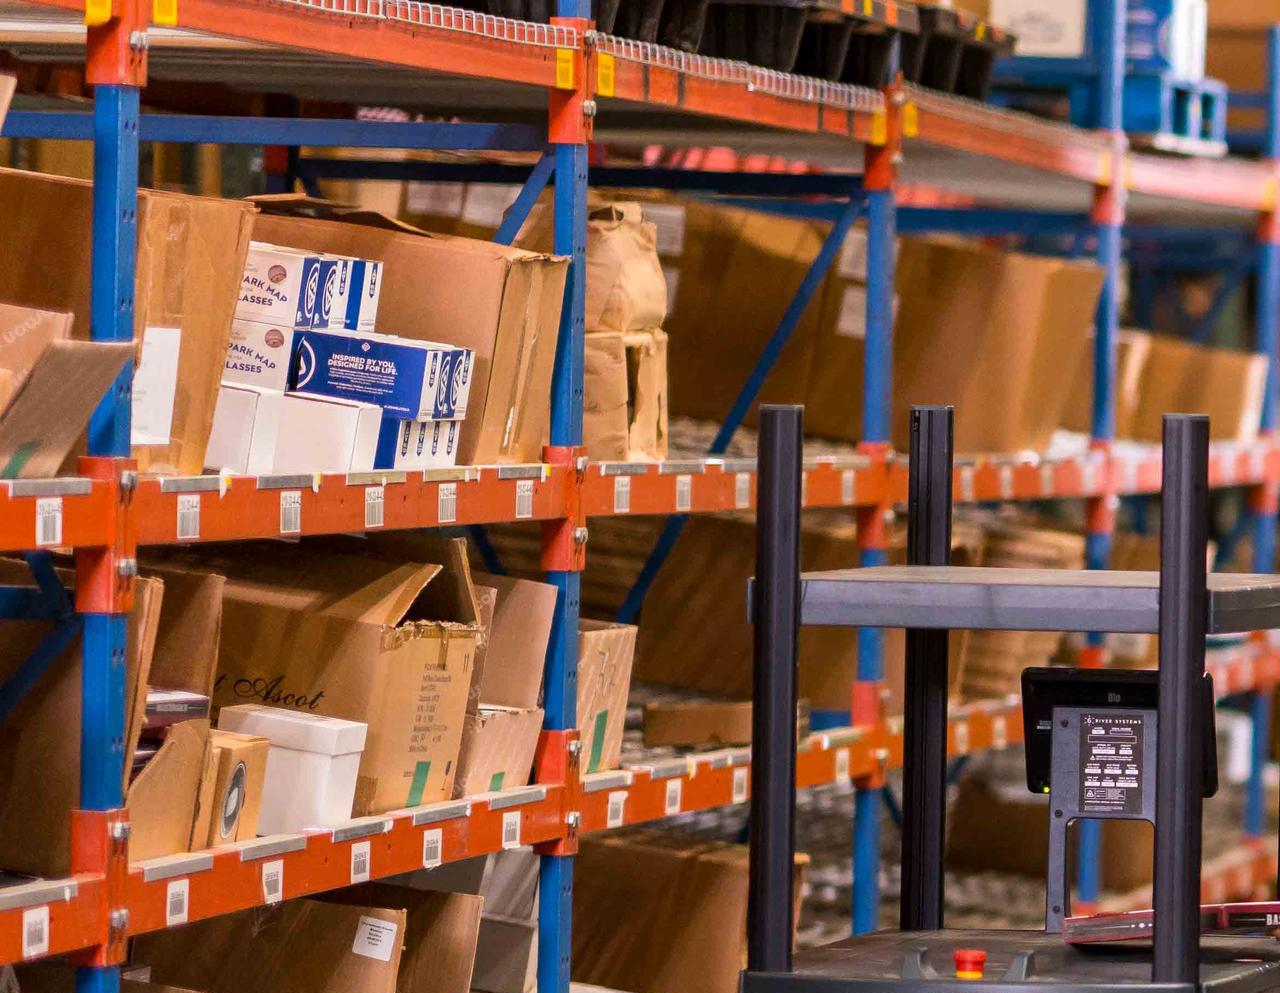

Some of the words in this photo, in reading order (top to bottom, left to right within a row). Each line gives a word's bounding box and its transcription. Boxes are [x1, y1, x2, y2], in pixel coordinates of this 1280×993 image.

[243, 275, 265, 290] ARK
[265, 284, 288, 303] MAP
[238, 295, 273, 307] ASSES
[225, 360, 262, 374] LASSES
[254, 352, 277, 370] MAP
[327, 358, 365, 371] DESIGNED
[365, 362, 381, 373] FOR
[381, 366, 398, 376] LIFE.
[332, 353, 366, 365] INSPIRED
[366, 357, 378, 367] BY
[233, 674, 326, 710] Ascot
